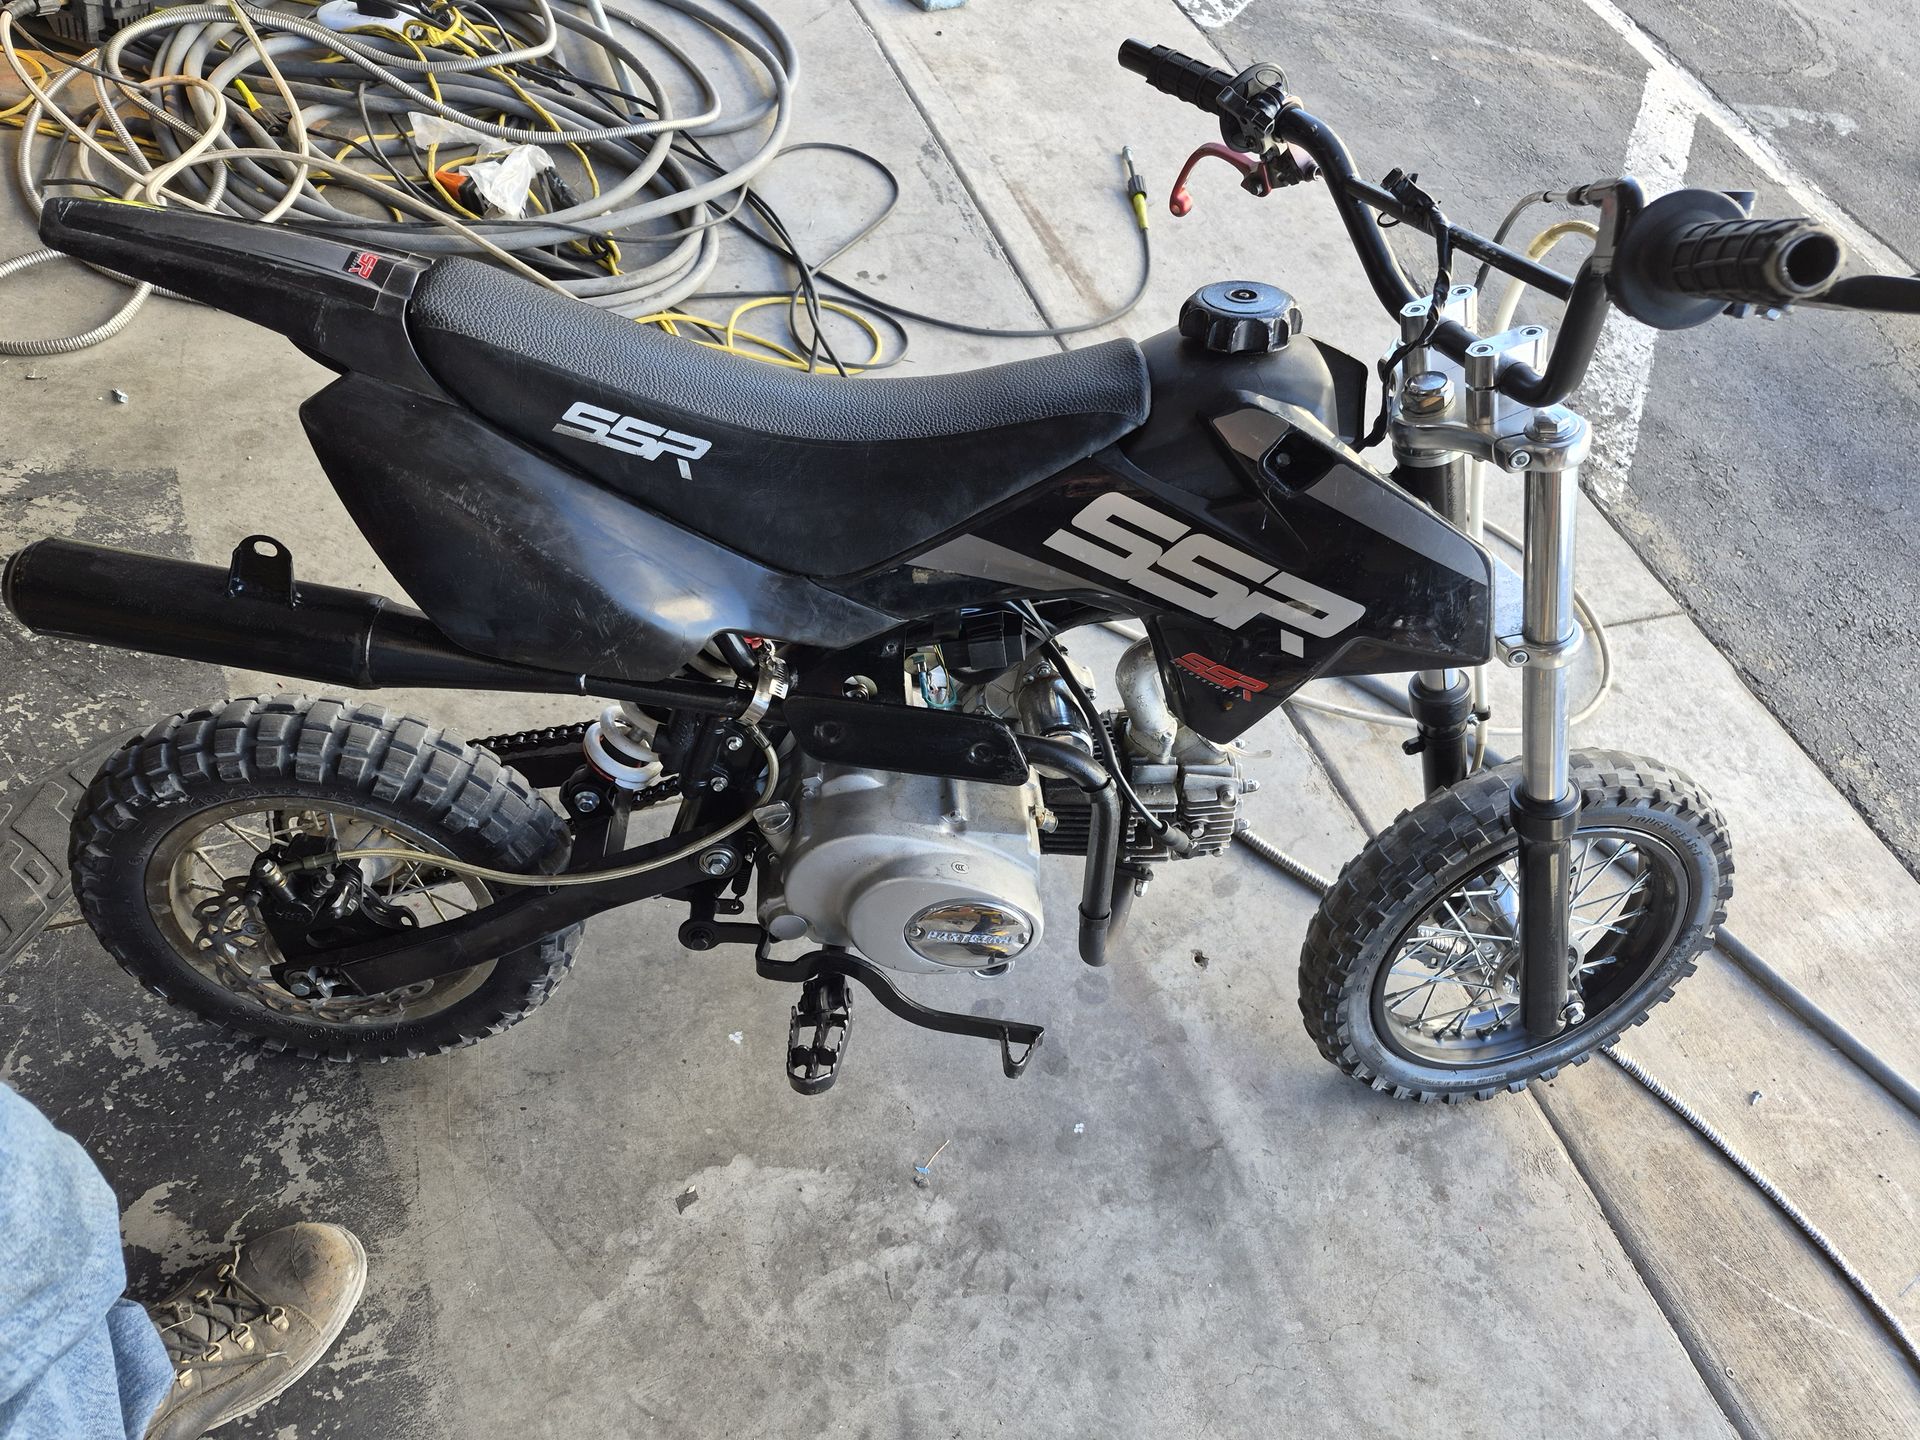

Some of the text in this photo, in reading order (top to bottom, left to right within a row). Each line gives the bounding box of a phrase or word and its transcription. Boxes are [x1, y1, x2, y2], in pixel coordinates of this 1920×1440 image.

[552, 401, 713, 481] SSR
[1043, 491, 1367, 659] SSR
[1172, 652, 1269, 702] SSR
